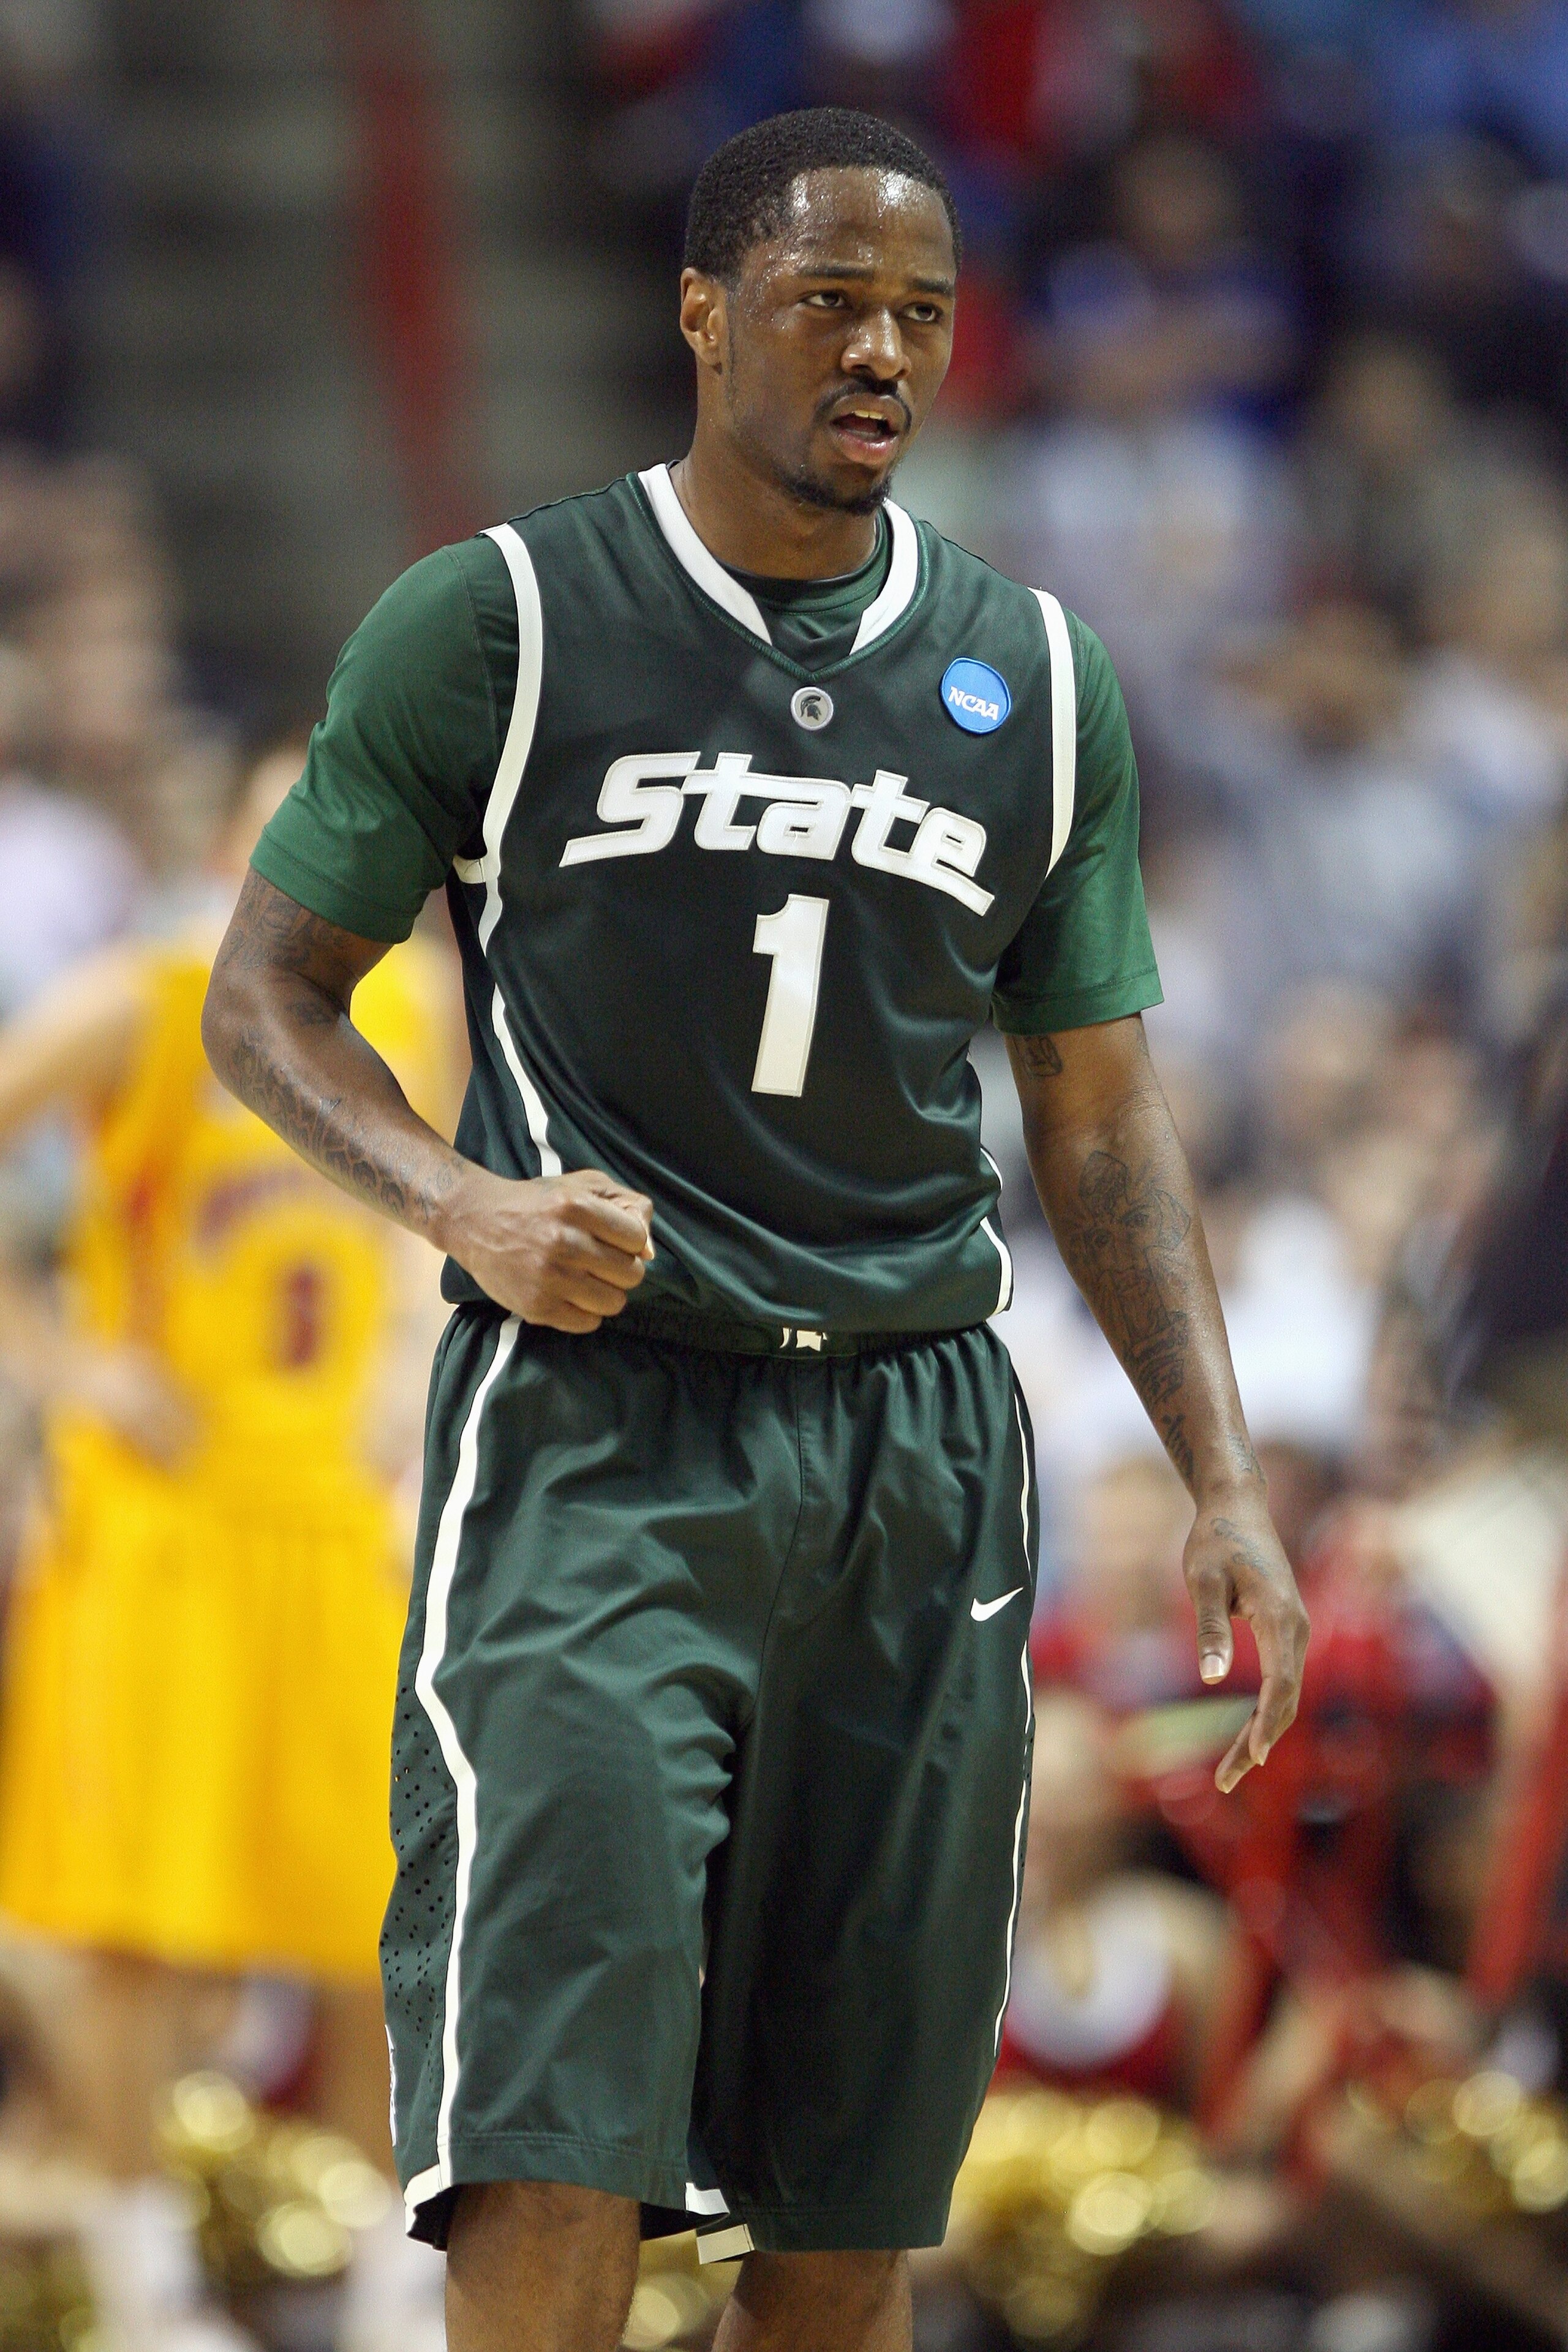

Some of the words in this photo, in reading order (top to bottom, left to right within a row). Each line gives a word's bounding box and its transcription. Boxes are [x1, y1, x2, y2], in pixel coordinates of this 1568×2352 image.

[948, 685, 1000, 721] NCAA
[559, 751, 995, 917] State
[751, 893, 830, 1098] 1
